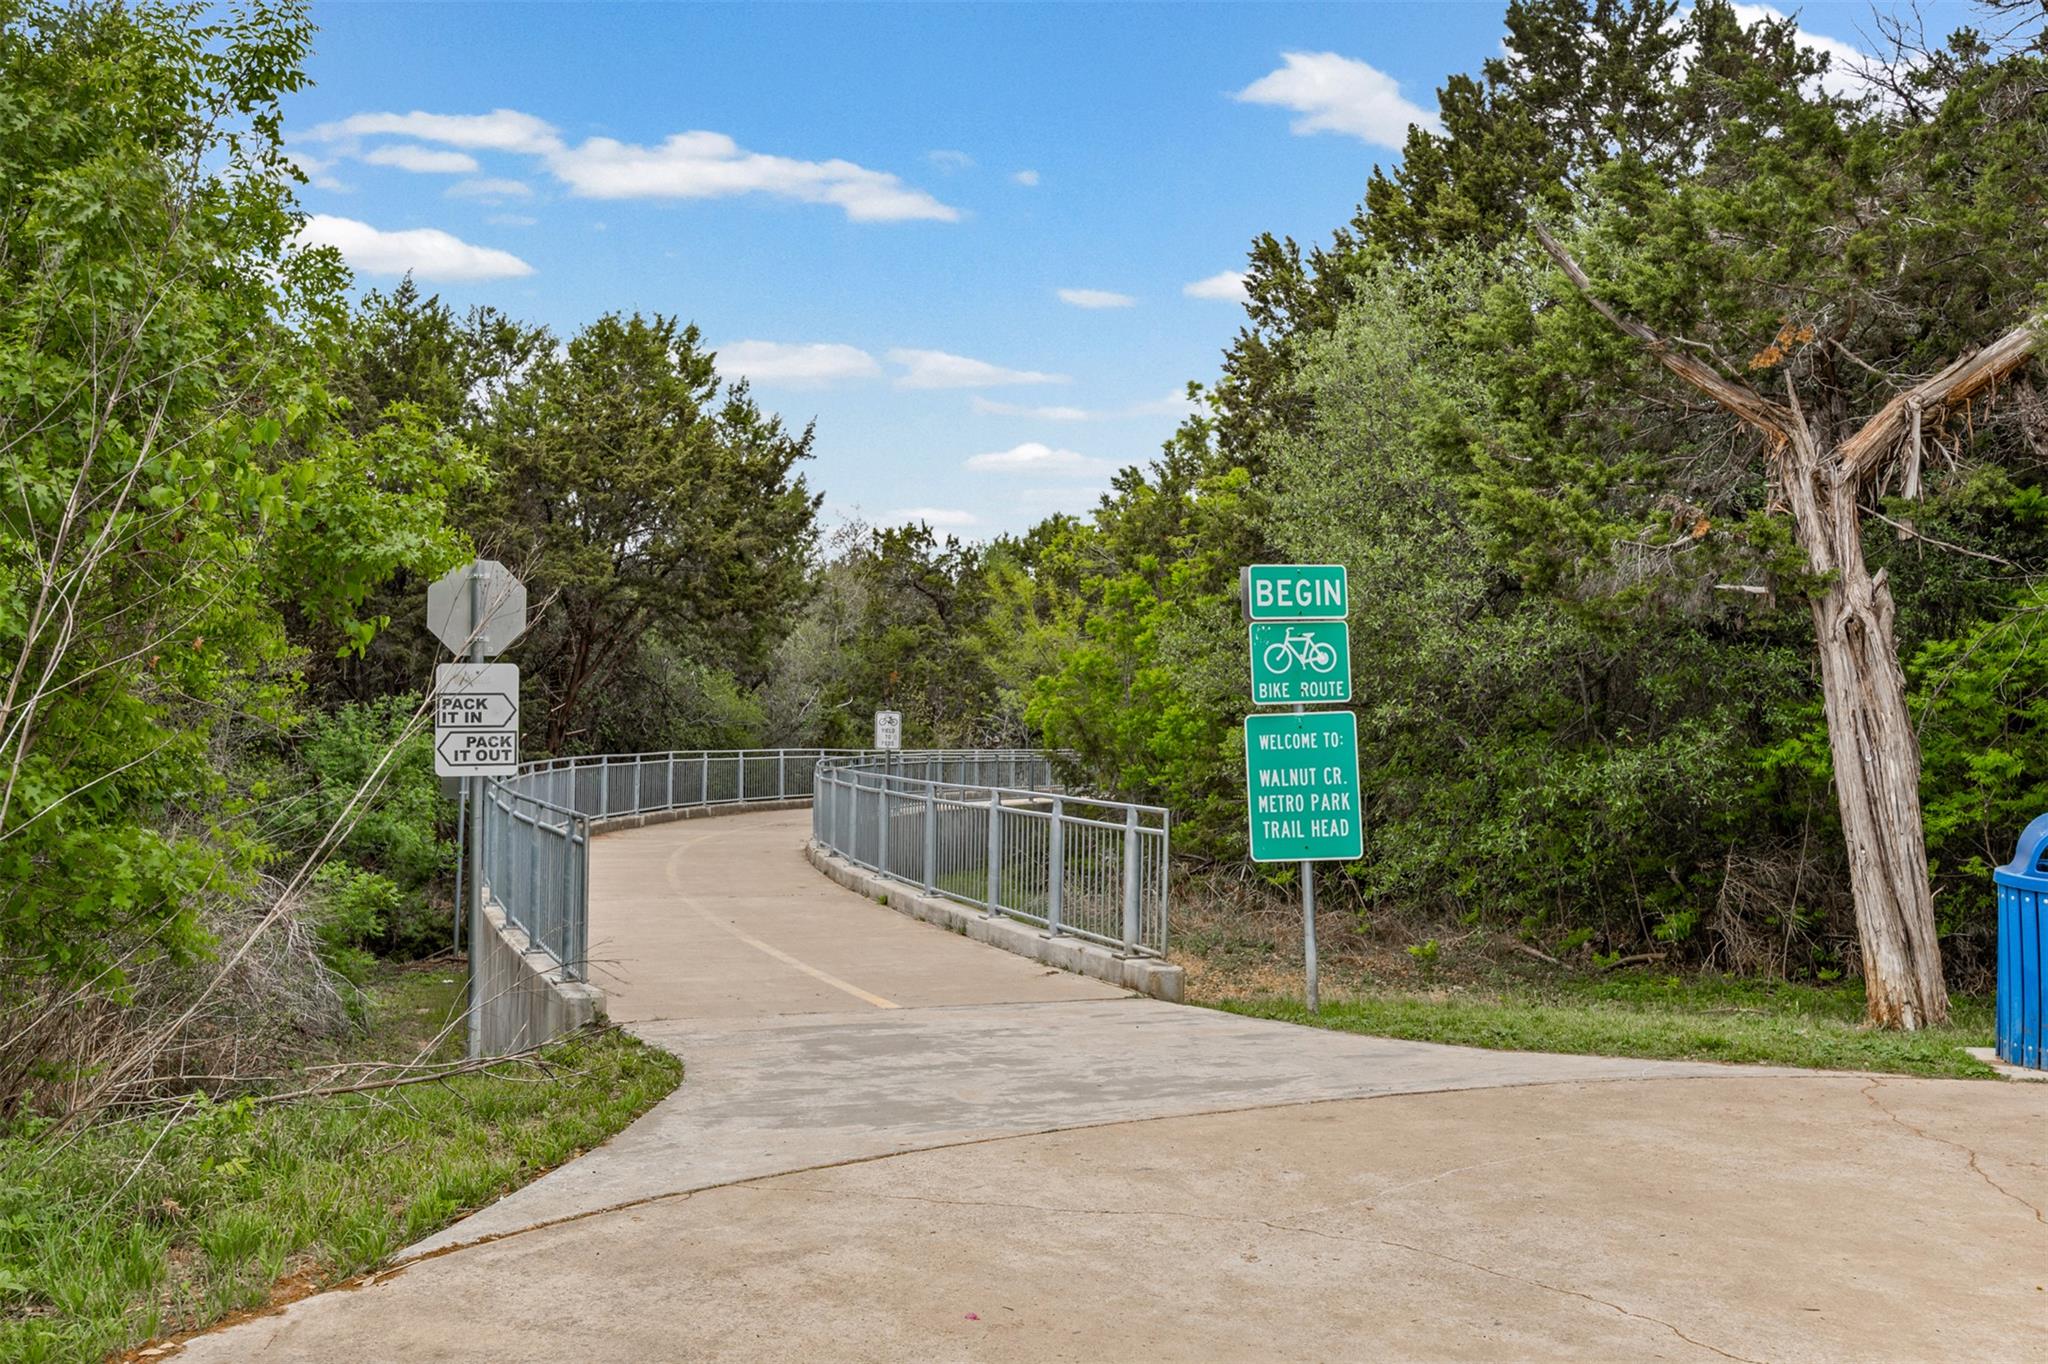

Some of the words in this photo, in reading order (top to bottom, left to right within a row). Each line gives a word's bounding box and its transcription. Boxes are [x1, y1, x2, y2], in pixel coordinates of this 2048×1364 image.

[1256, 579, 1341, 606] BEGIN
[1259, 682, 1290, 698] BIKE
[1301, 681, 1344, 697] ROUTE
[442, 698, 488, 710] PACK
[442, 712, 458, 724] IT
[464, 711, 482, 723] IN
[466, 736, 512, 748] PACK
[1259, 733, 1318, 750] WELCOME
[1323, 732, 1344, 748] TO:
[454, 750, 471, 762] IT
[476, 749, 512, 761] OUT
[1259, 768, 1316, 787] WALNUT
[1323, 767, 1348, 785] CR.
[1258, 795, 1304, 813] METRO
[1311, 792, 1350, 811] PARK
[1263, 821, 1304, 839] TRAIL
[1311, 818, 1349, 838] HEAD
